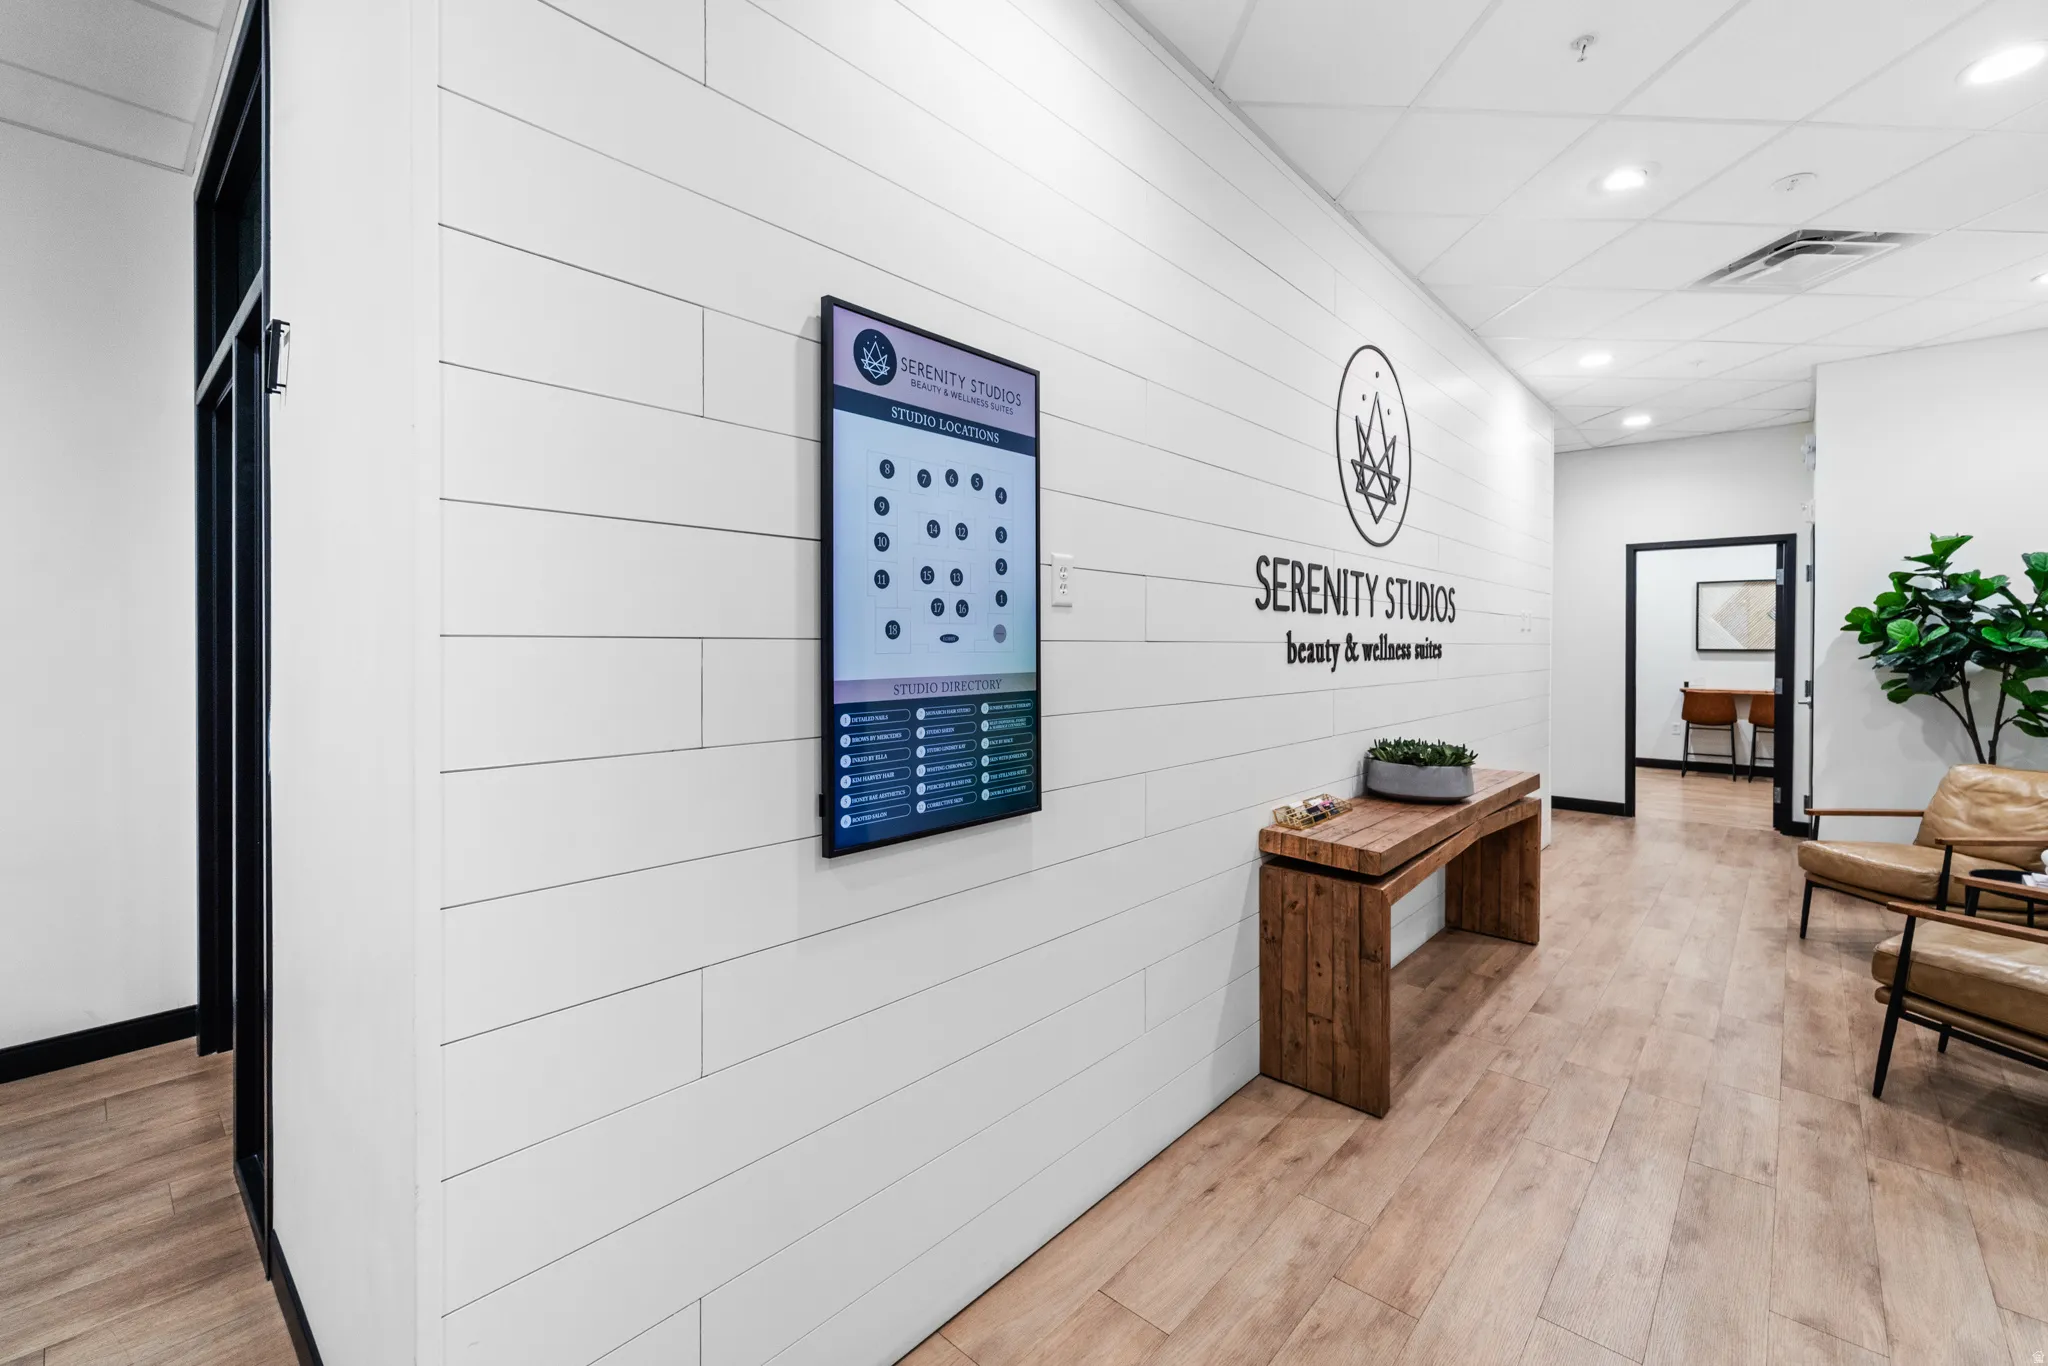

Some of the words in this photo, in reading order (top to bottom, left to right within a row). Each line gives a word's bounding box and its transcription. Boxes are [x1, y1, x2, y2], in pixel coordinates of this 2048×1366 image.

[901, 357, 966, 390] SERENITY
[970, 379, 1022, 407] STUDIOS
[910, 379, 942, 396] BEAUTY
[943, 388, 949, 397] &
[950, 390, 989, 409] WELLNESS
[990, 402, 1014, 416] SUITES
[891, 406, 936, 428] STUDIO
[939, 418, 1000, 444] LOCATIONS
[884, 463, 891, 475] 8
[921, 473, 927, 485] 7
[949, 473, 955, 484] 6
[974, 477, 980, 488] 5
[998, 490, 1004, 501] 4
[879, 501, 885, 512] 9
[929, 523, 938, 534] 14
[957, 527, 966, 537] 12
[998, 530, 1004, 541] 3
[877, 536, 887, 548] 10
[998, 562, 1004, 572] 2
[877, 573, 887, 585] 11
[923, 570, 932, 581] 15
[952, 572, 961, 583] 13
[1255, 555, 1379, 618] SERENITY
[1385, 576, 1456, 623] STUDIOS
[999, 593, 1004, 604] 1
[933, 602, 943, 613] 17
[958, 603, 967, 614] 16
[888, 624, 898, 636] 18
[1286, 630, 1341, 673] beauty
[1344, 632, 1359, 662] &
[1362, 633, 1411, 662] wellness
[1415, 637, 1443, 660] suites
[893, 682, 938, 696] STUDIO
[941, 679, 1003, 693] DIRECTORY
[876, 732, 902, 740] MERCEDES
[926, 728, 942, 736] STUDIO
[926, 746, 942, 754] STUDIO
[852, 756, 868, 764] INKED
[852, 776, 862, 784] KIM
[862, 774, 882, 782] HARVEY
[879, 790, 906, 798] AESTHETICS
[926, 798, 954, 808] CORRECTIVE
[852, 814, 872, 823] ROOTED
[872, 812, 888, 820] SALON
